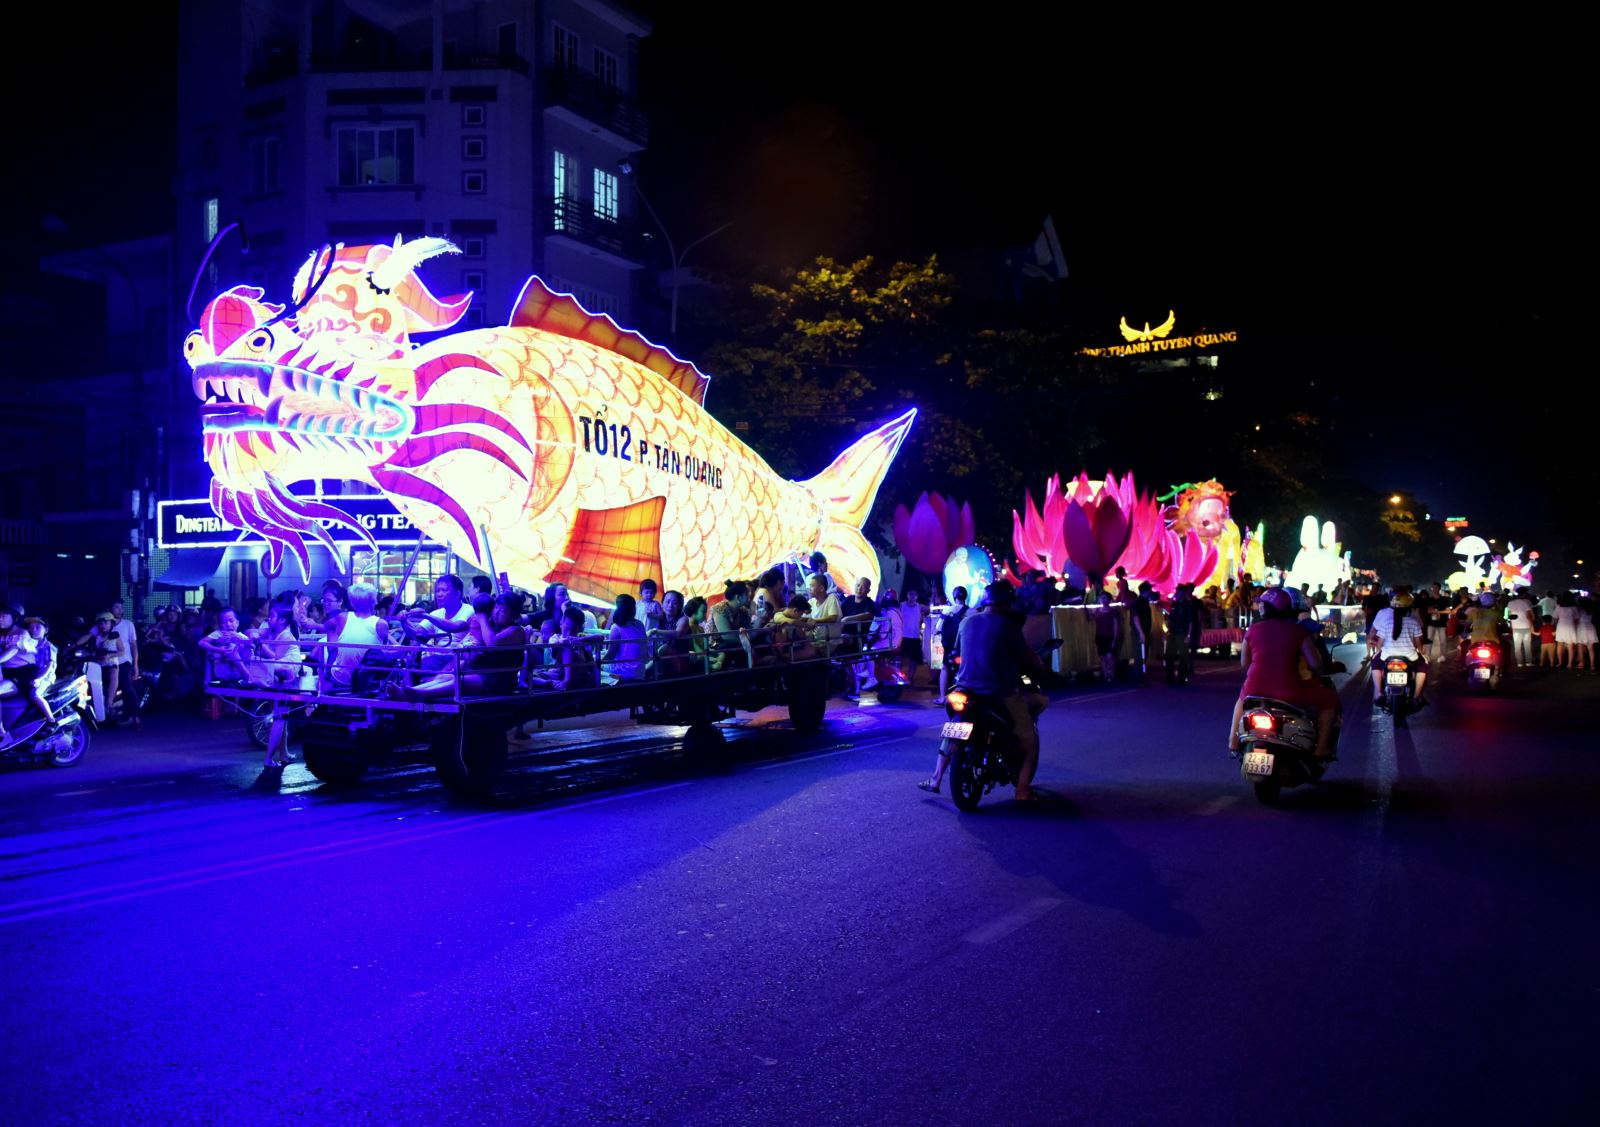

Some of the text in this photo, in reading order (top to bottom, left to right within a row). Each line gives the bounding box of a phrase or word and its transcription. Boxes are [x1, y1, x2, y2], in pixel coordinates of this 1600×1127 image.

[1107, 342, 1150, 356] THANH
[1194, 332, 1236, 348] QUANG
[685, 455, 722, 490] QUANG
[176, 515, 220, 533] DINGTEA
